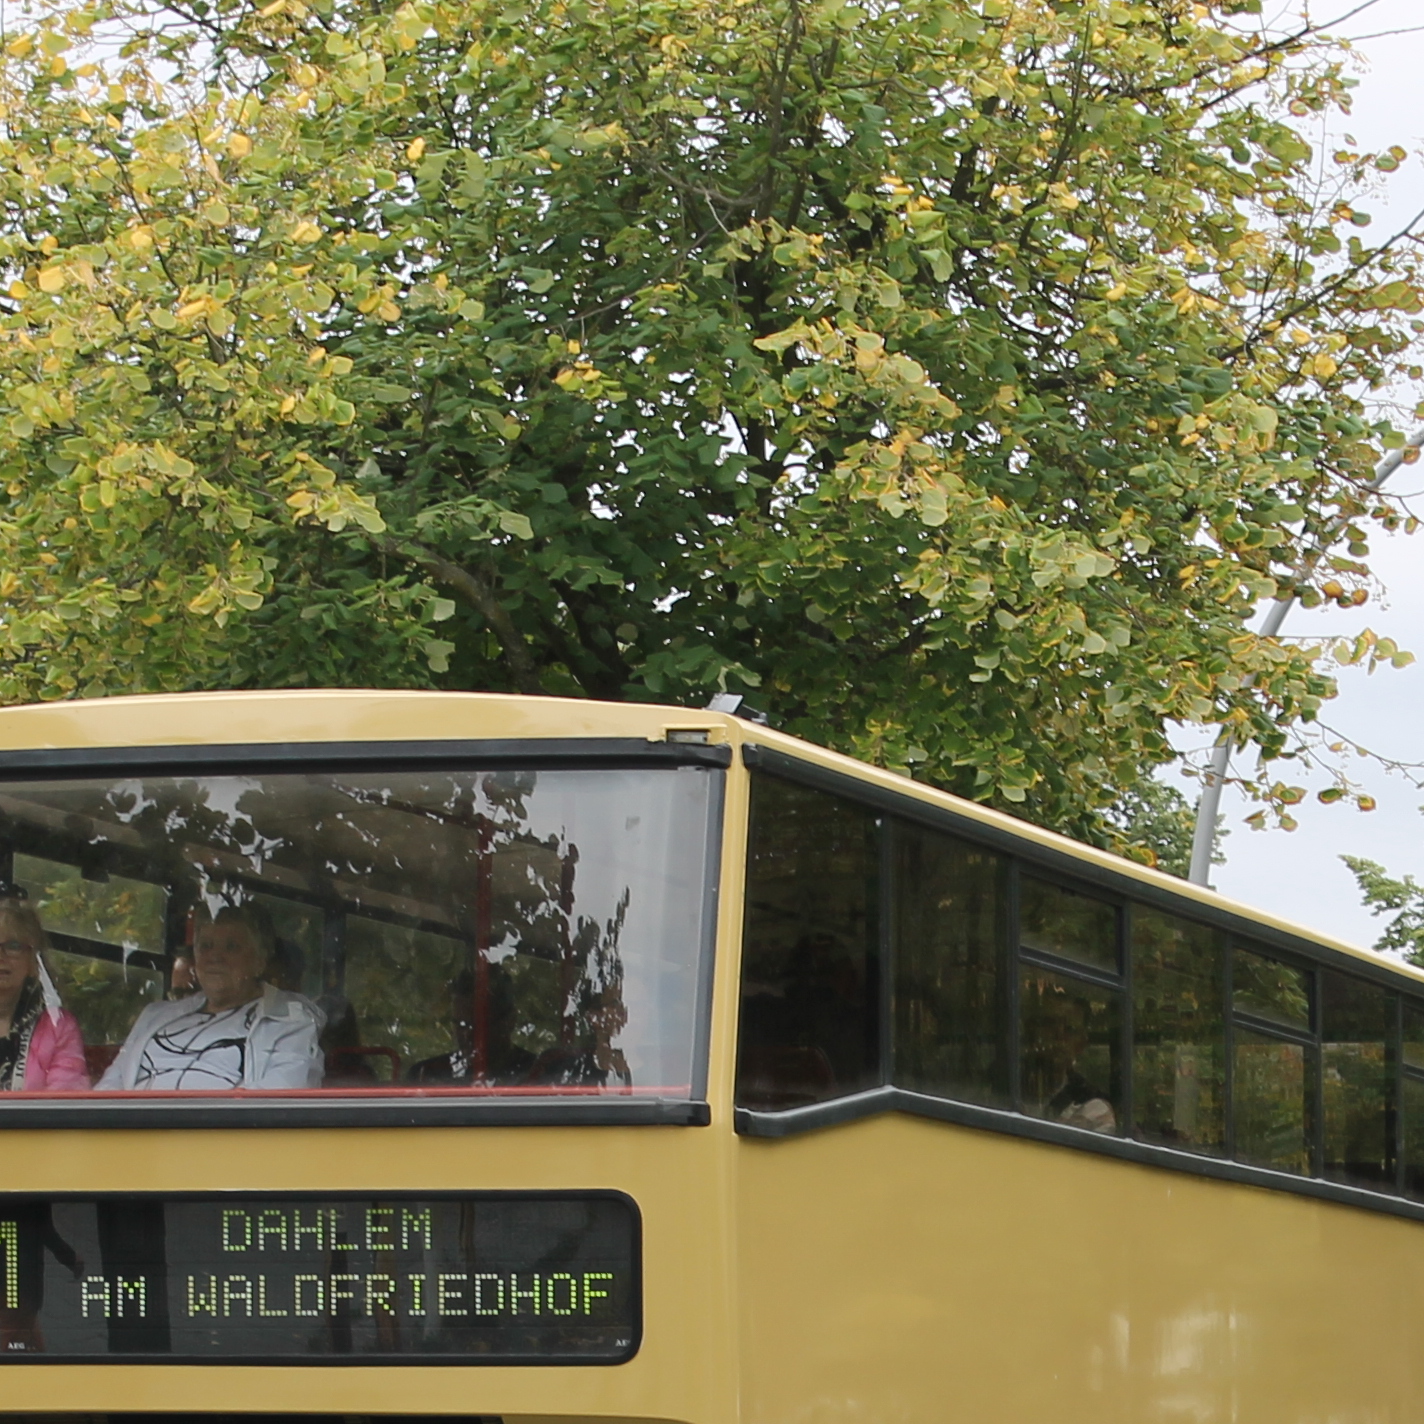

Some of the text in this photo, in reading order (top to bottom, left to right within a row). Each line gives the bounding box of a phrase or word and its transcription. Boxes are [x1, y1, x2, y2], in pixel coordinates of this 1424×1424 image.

[222, 1208, 433, 1253] DAHLEM
[81, 1271, 614, 1319] AM WALDFRIEDHOF
